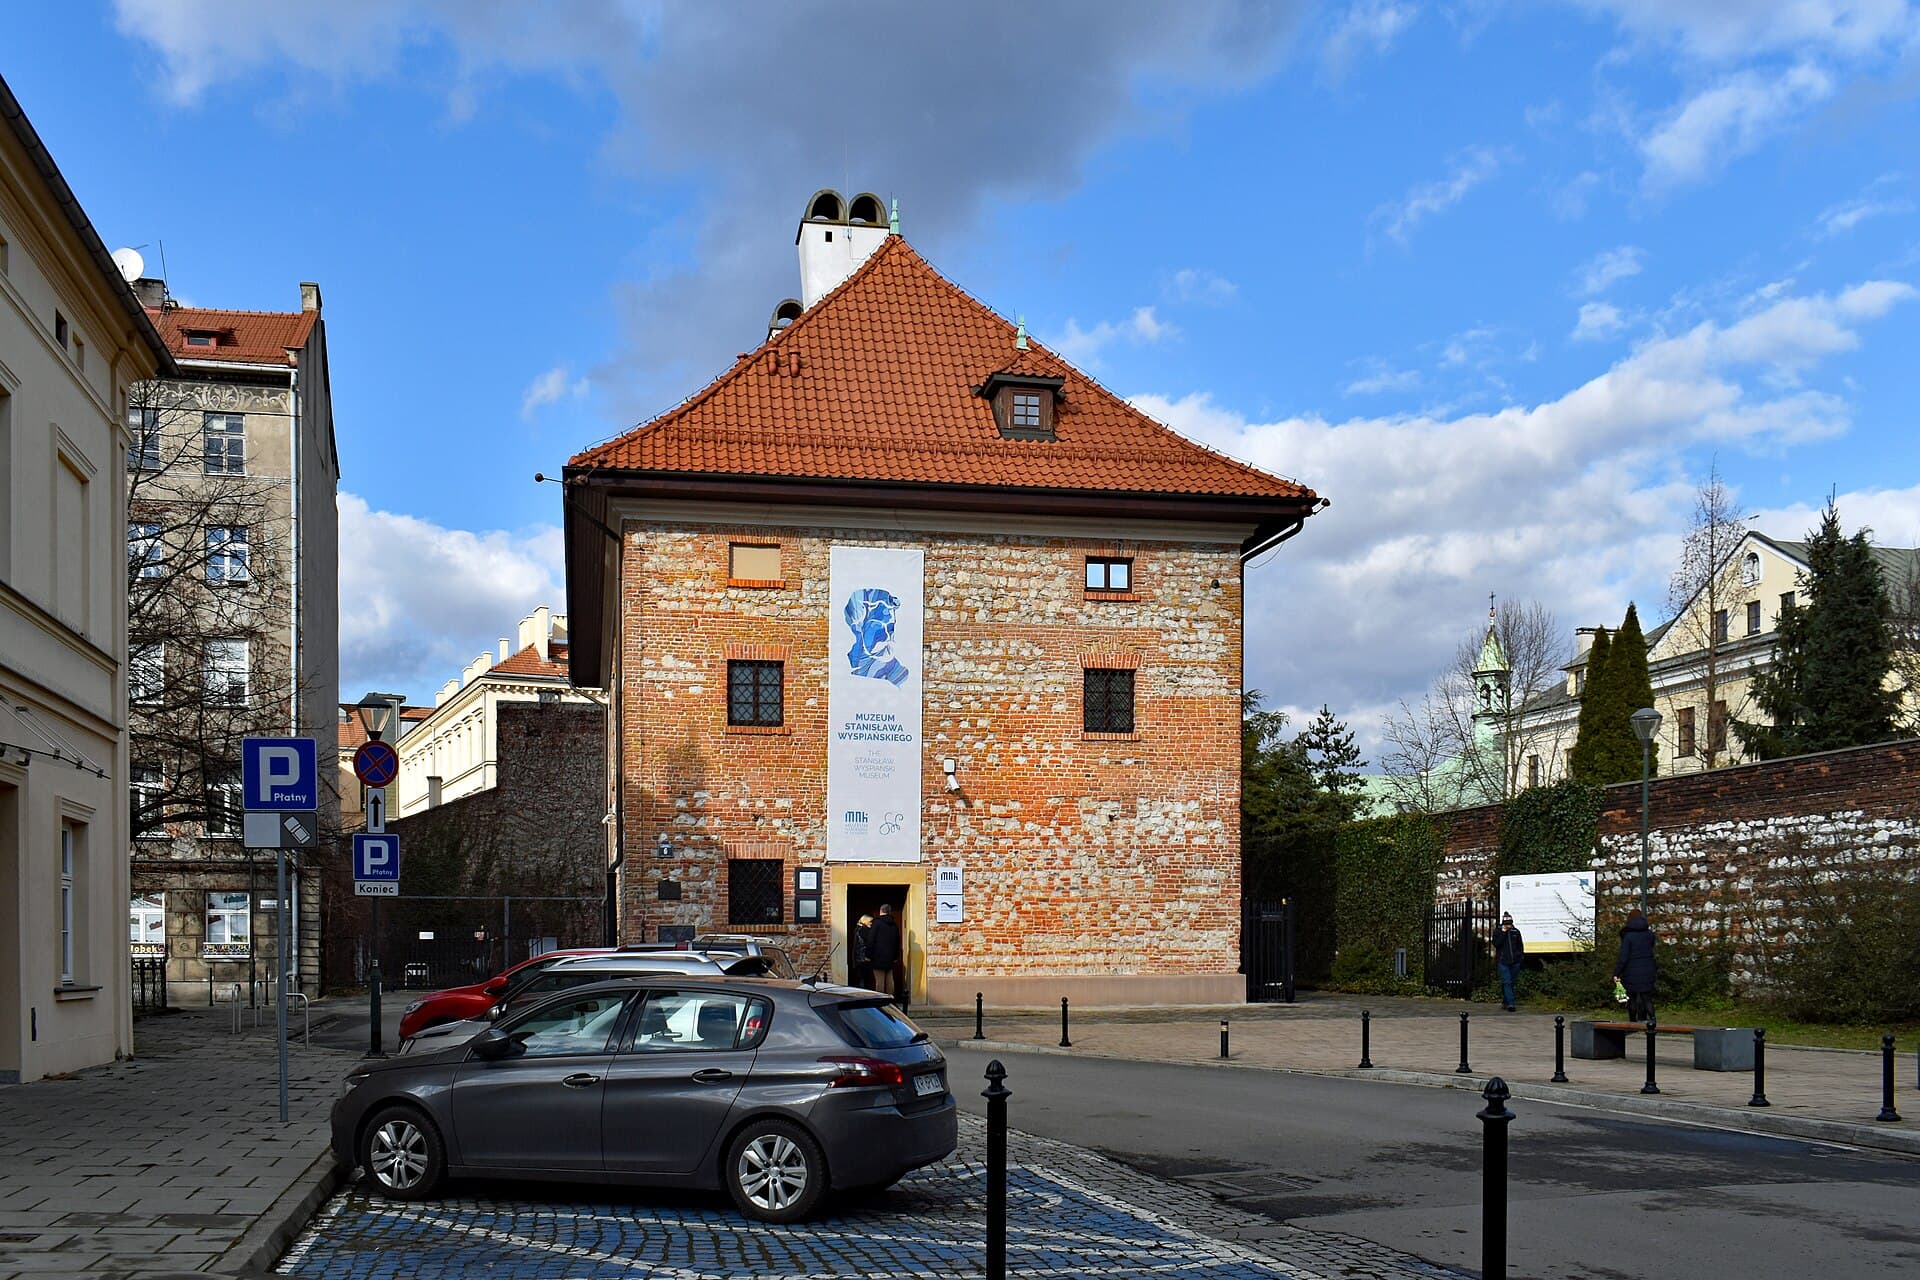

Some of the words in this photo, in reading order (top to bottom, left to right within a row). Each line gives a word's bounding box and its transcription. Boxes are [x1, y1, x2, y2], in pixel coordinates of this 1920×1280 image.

[855, 713, 895, 722] MUZEUM
[845, 722, 903, 732] STANISŁAWA
[838, 732, 912, 742] WYSPIAŃSKIEGO
[259, 746, 300, 801] P
[274, 792, 307, 804] Płatny
[364, 840, 389, 874] P
[360, 884, 394, 894] Koniec
